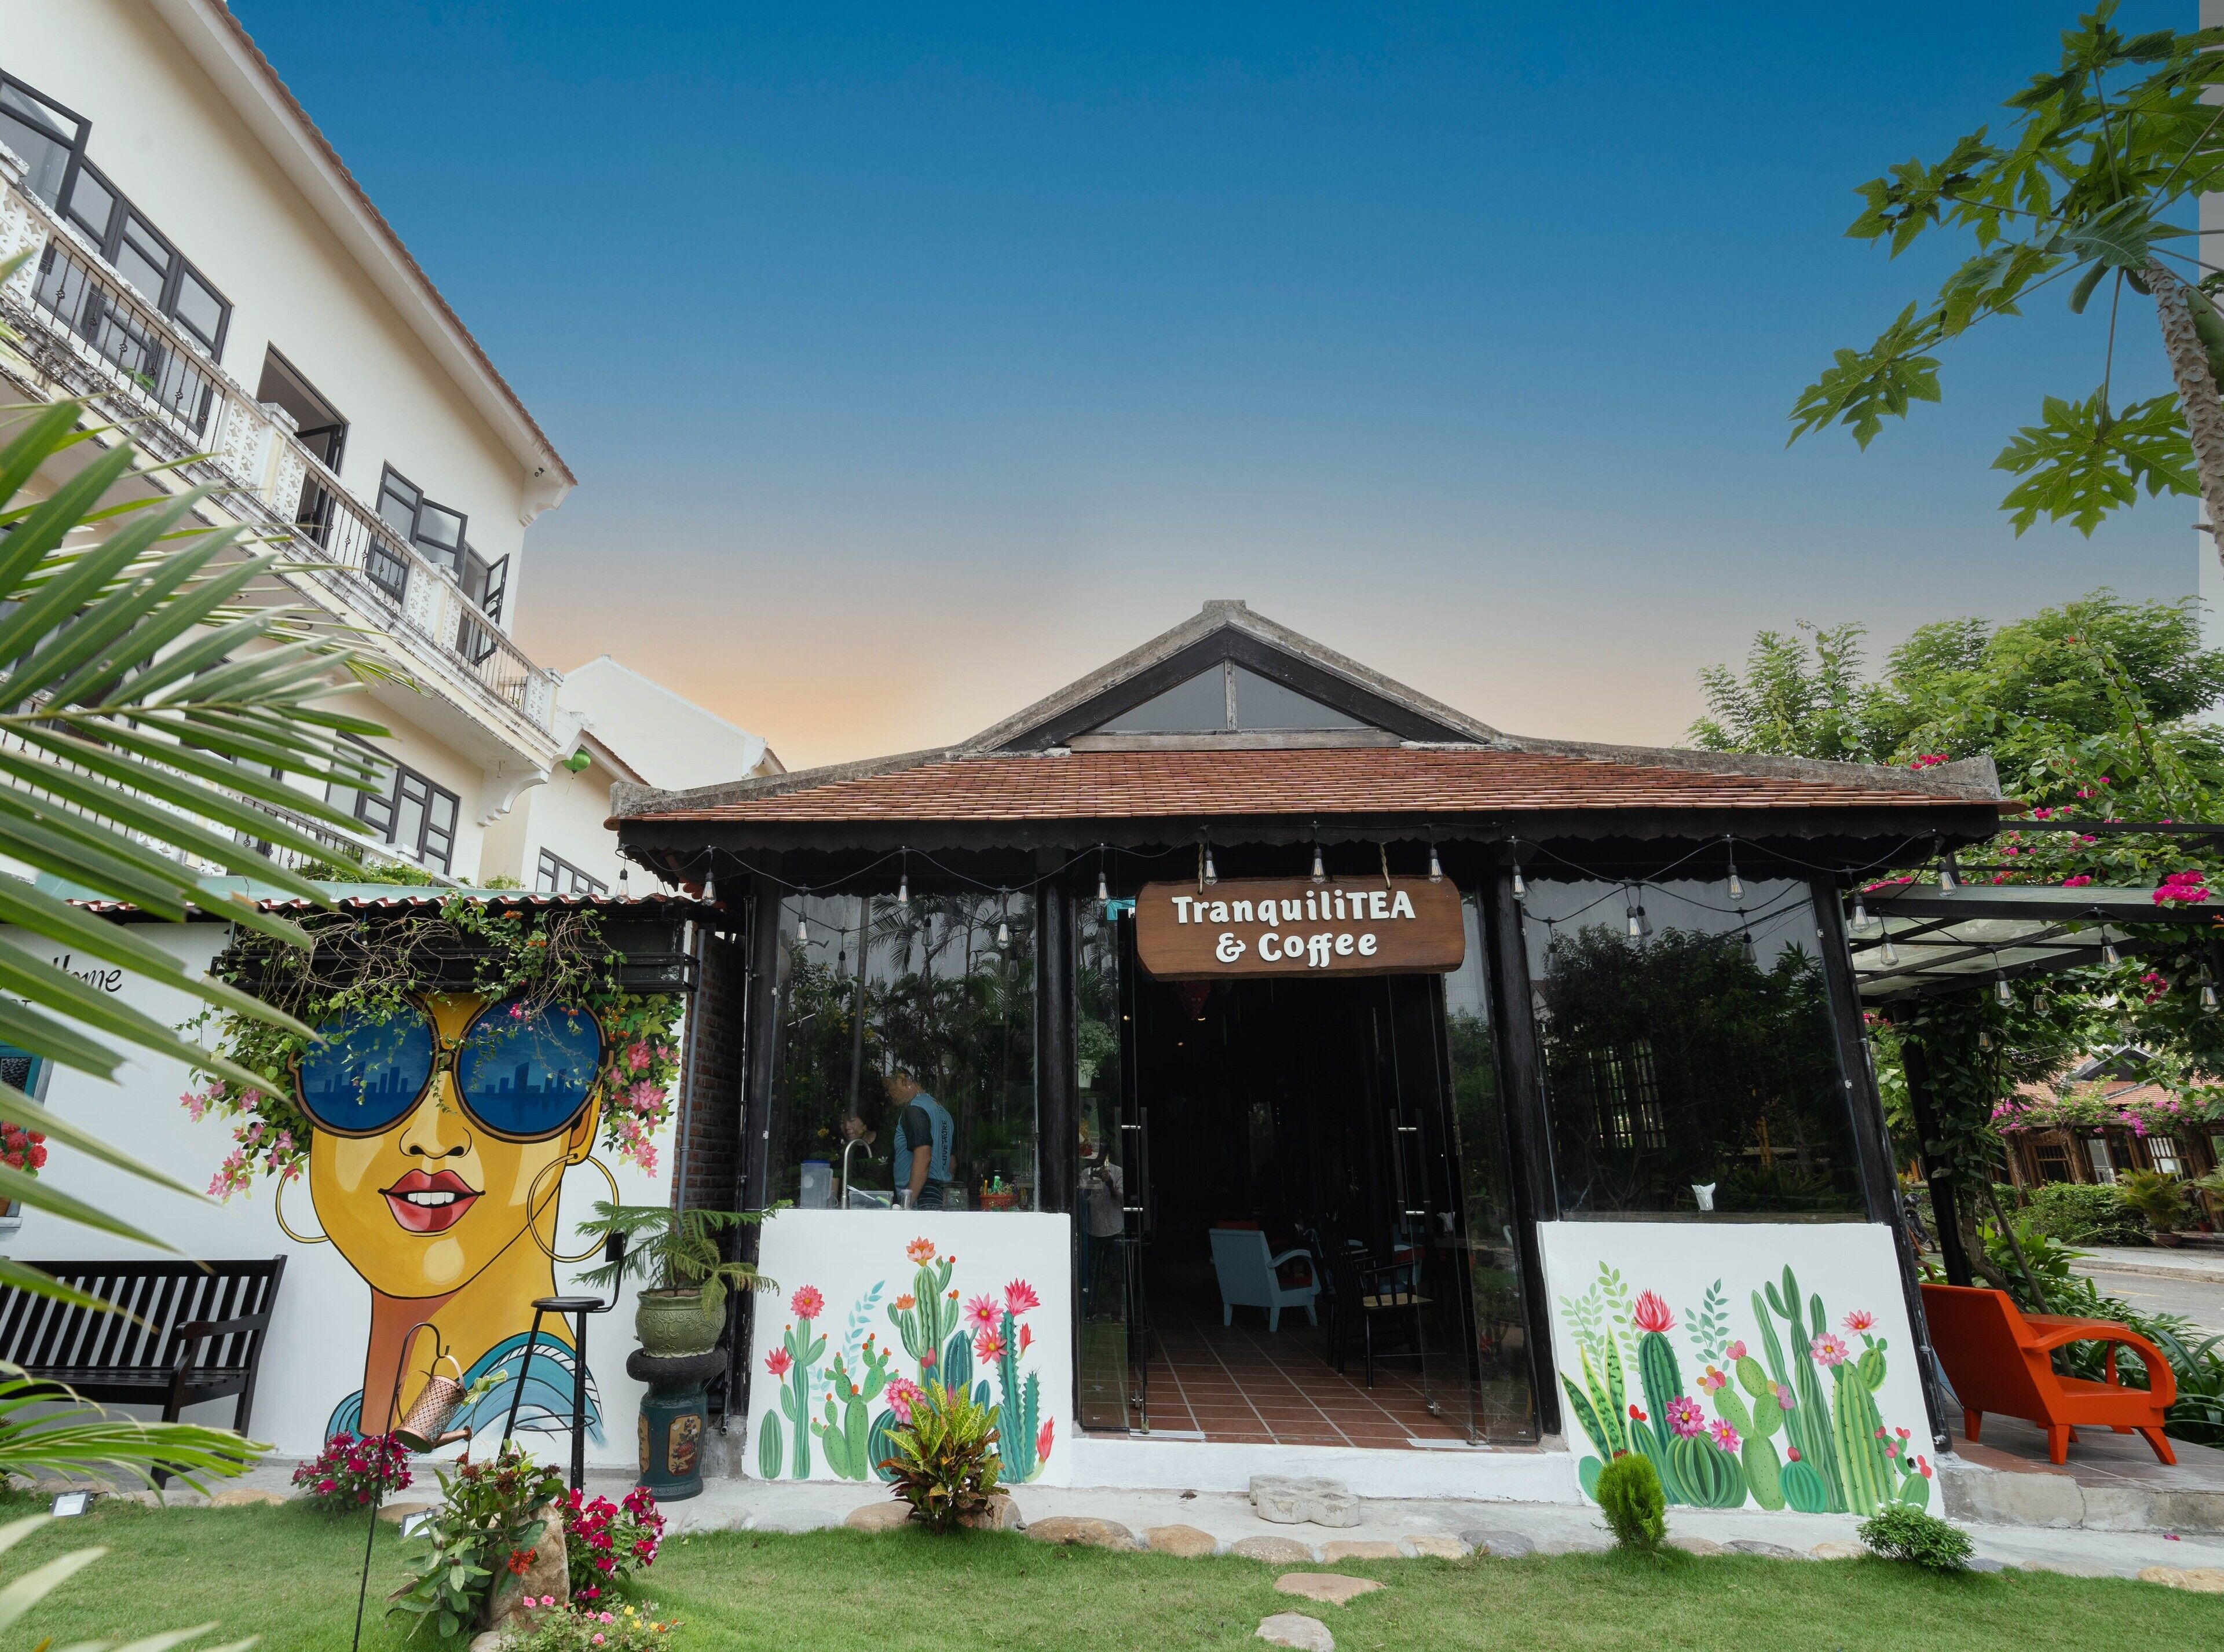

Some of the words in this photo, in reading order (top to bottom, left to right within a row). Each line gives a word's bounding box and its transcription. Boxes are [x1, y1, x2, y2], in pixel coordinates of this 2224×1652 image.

[1172, 889, 1415, 926] TranquiliTEA
[1216, 932, 1246, 963] &
[1258, 932, 1377, 968] Coffee
